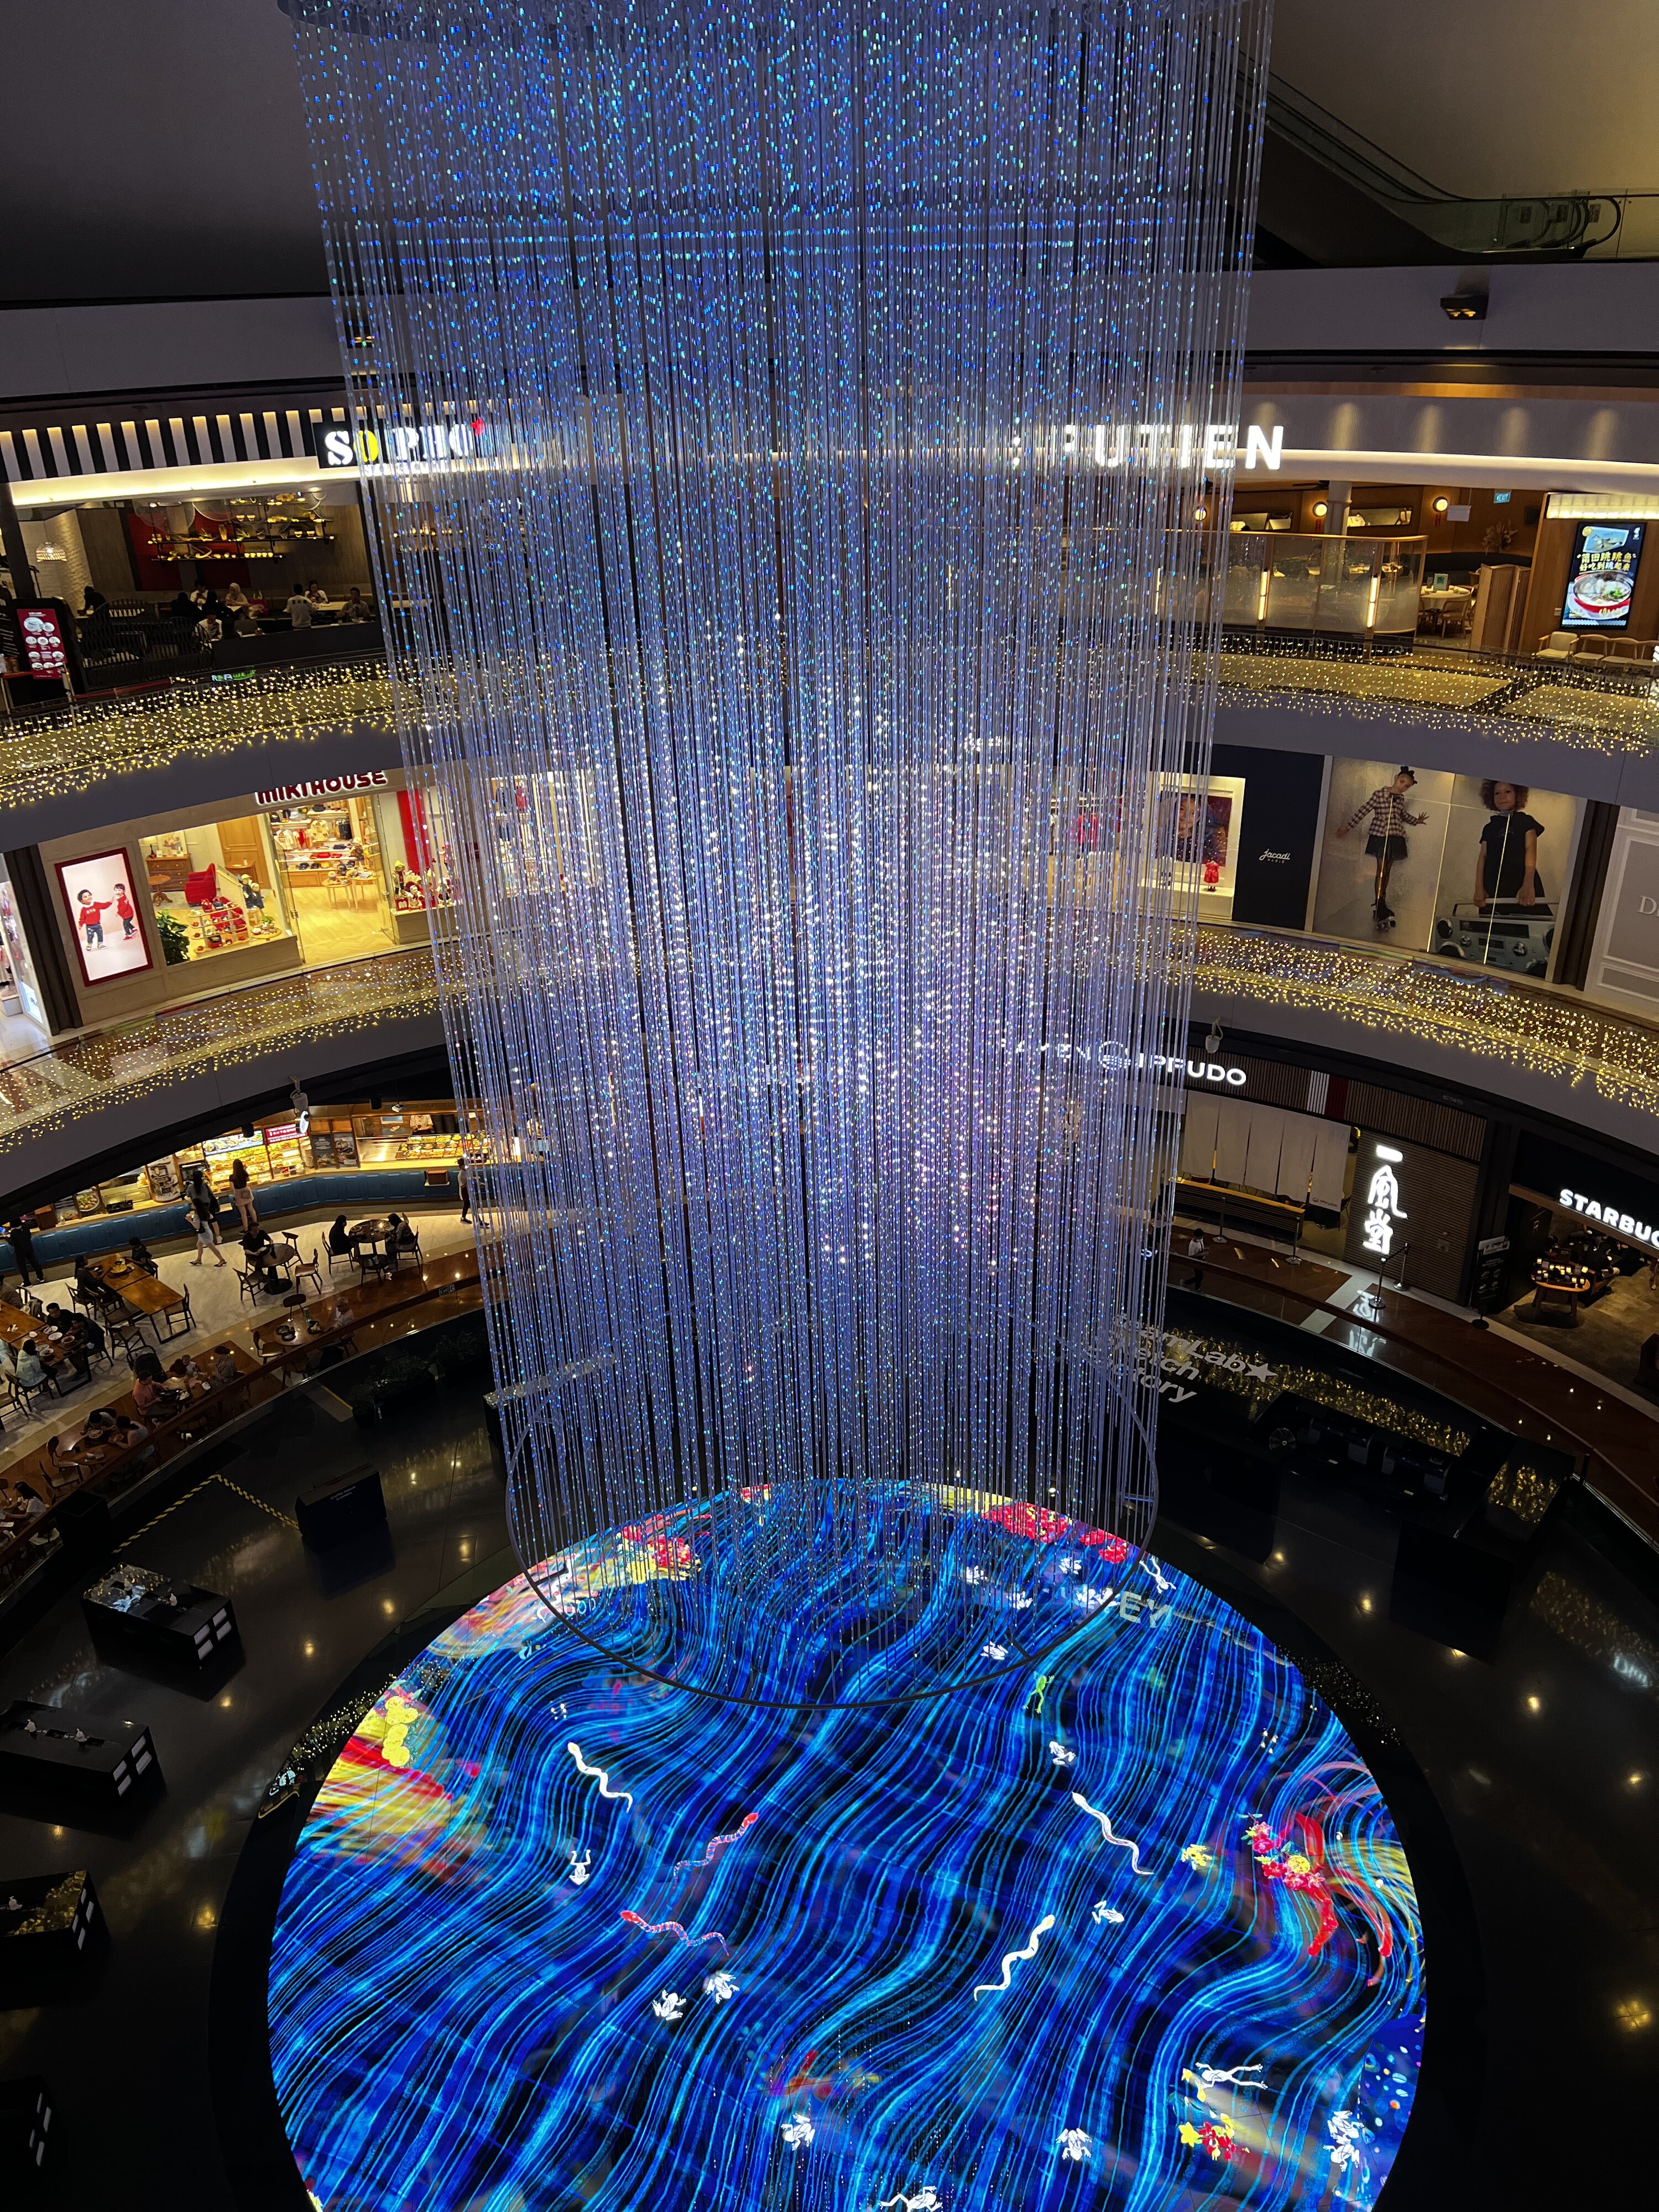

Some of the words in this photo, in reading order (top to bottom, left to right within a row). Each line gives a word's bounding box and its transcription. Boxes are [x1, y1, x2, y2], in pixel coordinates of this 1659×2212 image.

[325, 430, 379, 466] SO
[1050, 424, 1284, 470] PUTIEN
[1637, 895, 1659, 918] D
[1138, 1053, 1246, 1086] IPPUDO
[1108, 1328, 1199, 1381] etch
